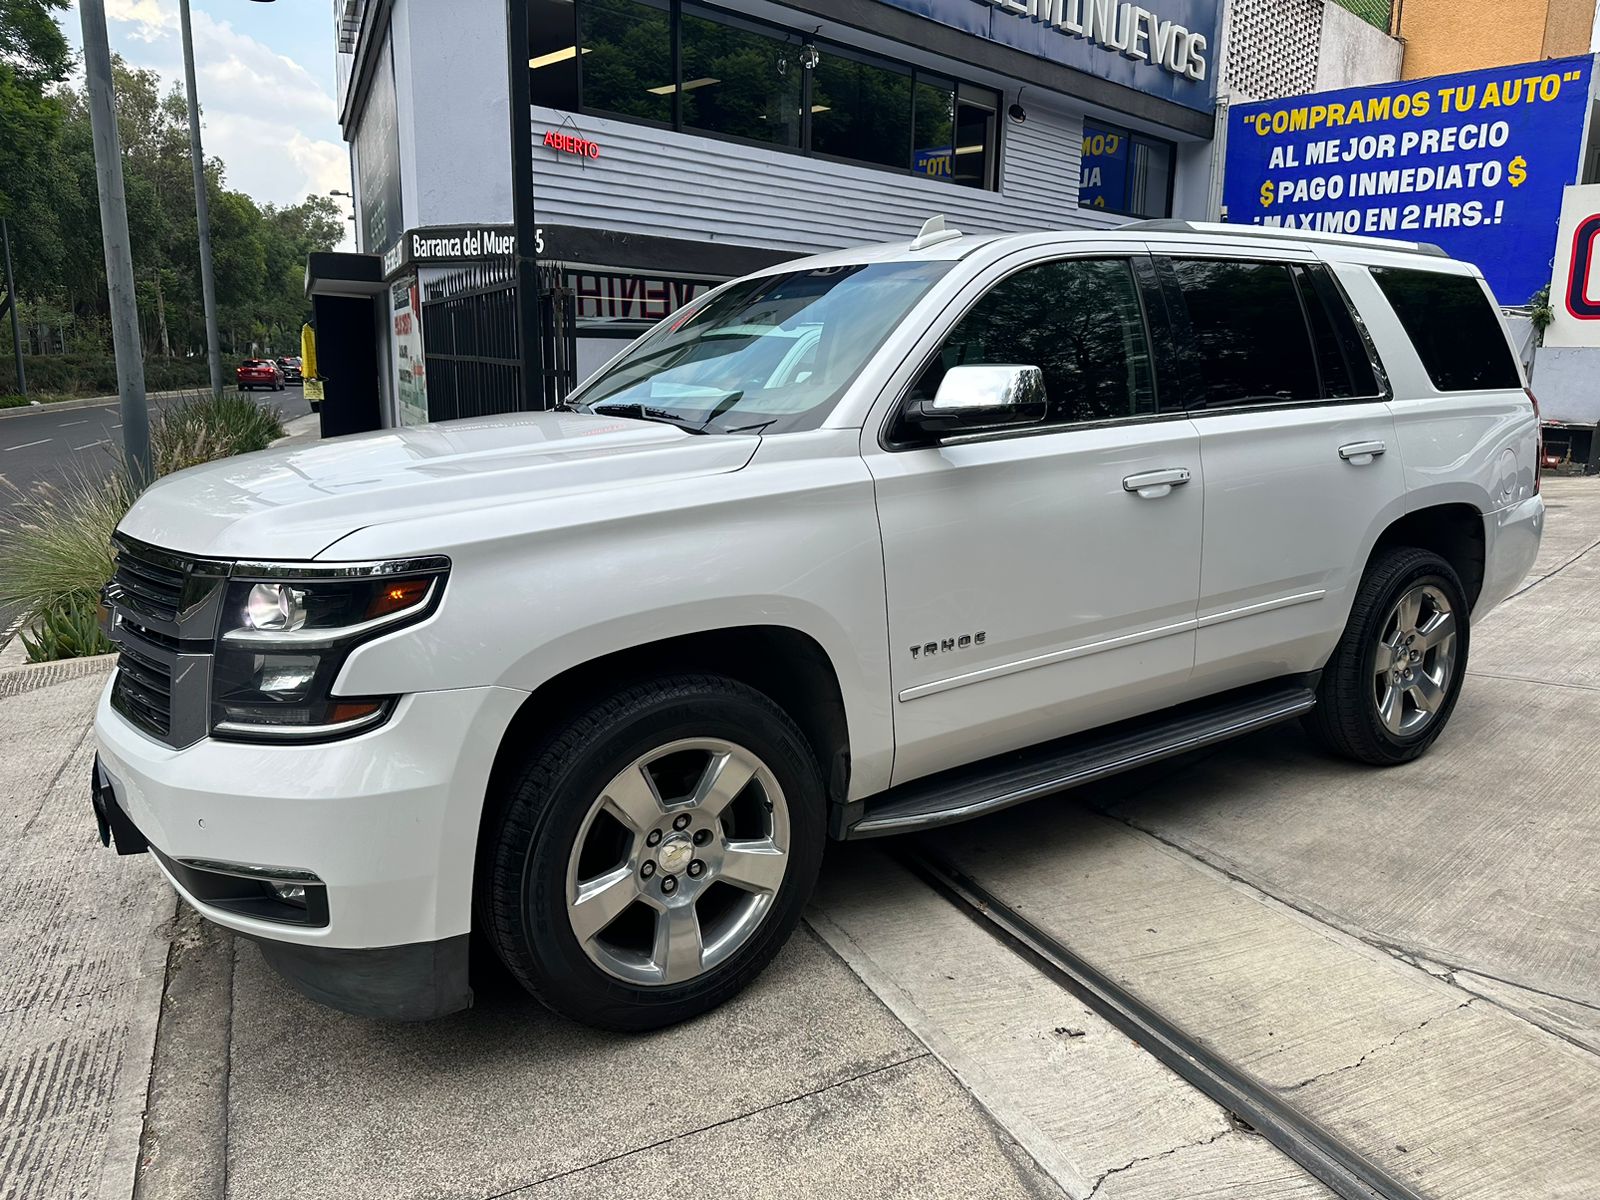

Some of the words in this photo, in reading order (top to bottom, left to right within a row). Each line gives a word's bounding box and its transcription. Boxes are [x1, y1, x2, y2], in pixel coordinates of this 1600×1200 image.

[1438, 86, 1475, 113] TU
[543, 130, 600, 160] ABIERTO
[1268, 144, 1299, 169] AL
[1305, 133, 1395, 166] MEJOR
[1400, 120, 1510, 157] PRECIO
[1277, 174, 1344, 204] PAGO
[1348, 160, 1502, 198] INMEDIATO
[1364, 207, 1398, 232] EN
[1400, 205, 1421, 230] 2
[412, 234, 462, 257] Barranca
[463, 230, 481, 256] del
[483, 231, 516, 255] Muer
[909, 630, 986, 660] TAHOE
